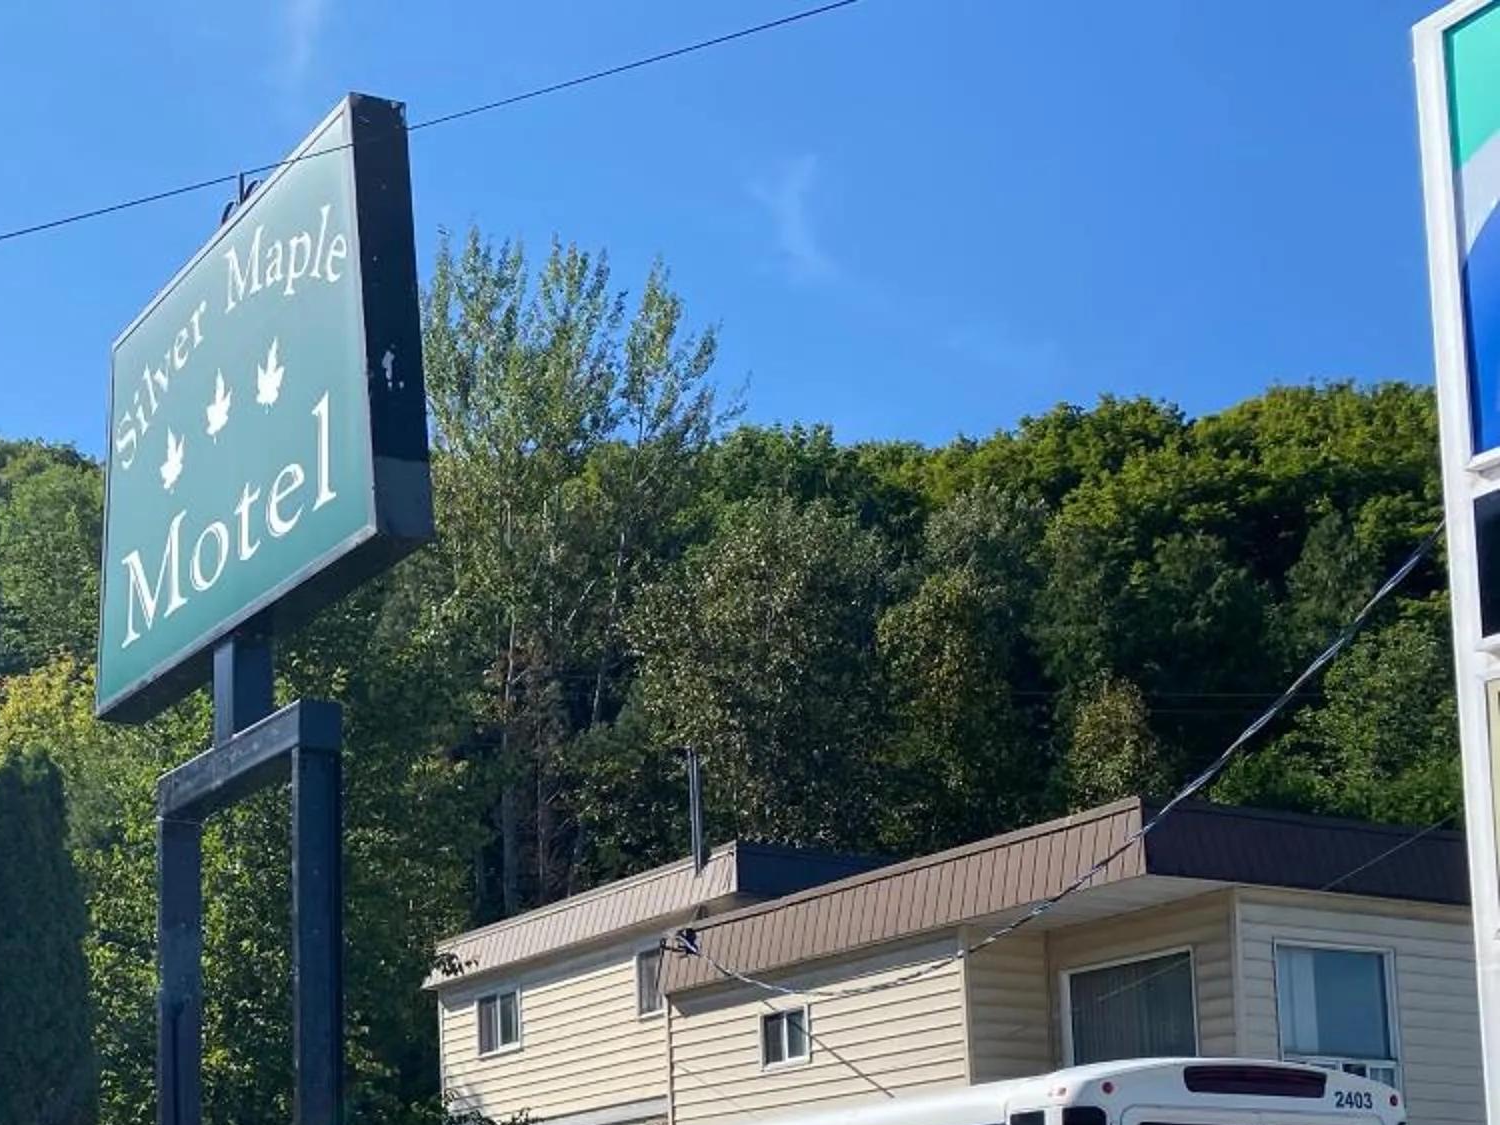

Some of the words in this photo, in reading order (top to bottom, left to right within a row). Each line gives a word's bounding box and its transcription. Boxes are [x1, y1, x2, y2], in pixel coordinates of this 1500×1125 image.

[115, 300, 207, 470] Silver
[223, 204, 348, 314] Maple
[120, 390, 338, 650] Motel
[1334, 1091, 1374, 1109] 2403
